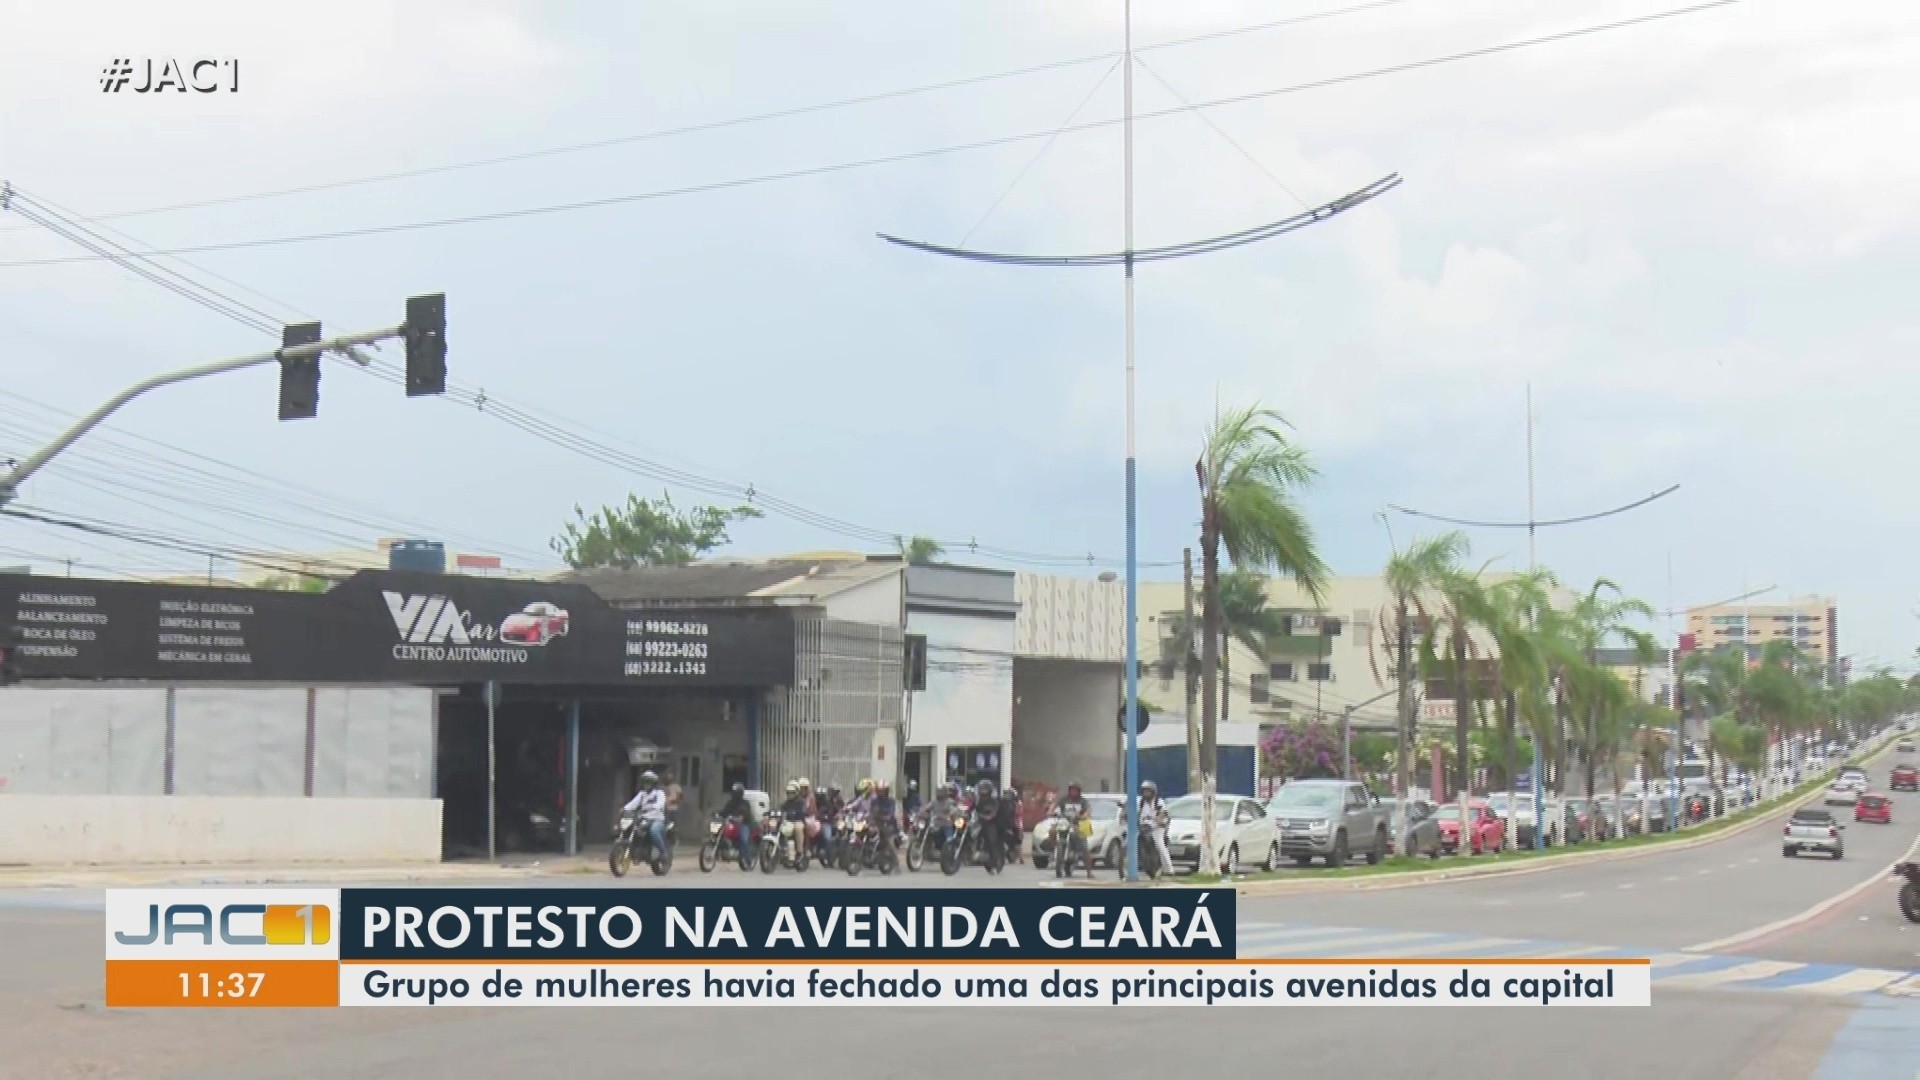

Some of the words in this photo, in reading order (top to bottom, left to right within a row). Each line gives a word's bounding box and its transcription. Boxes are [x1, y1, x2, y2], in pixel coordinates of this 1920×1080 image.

[19, 592, 97, 607] ALINHAMENTO
[18, 610, 109, 625] BALANCEAMENTO
[382, 590, 471, 645] VIA
[392, 643, 446, 662] CENTRO
[448, 646, 528, 664] AUTOMOTIVO
